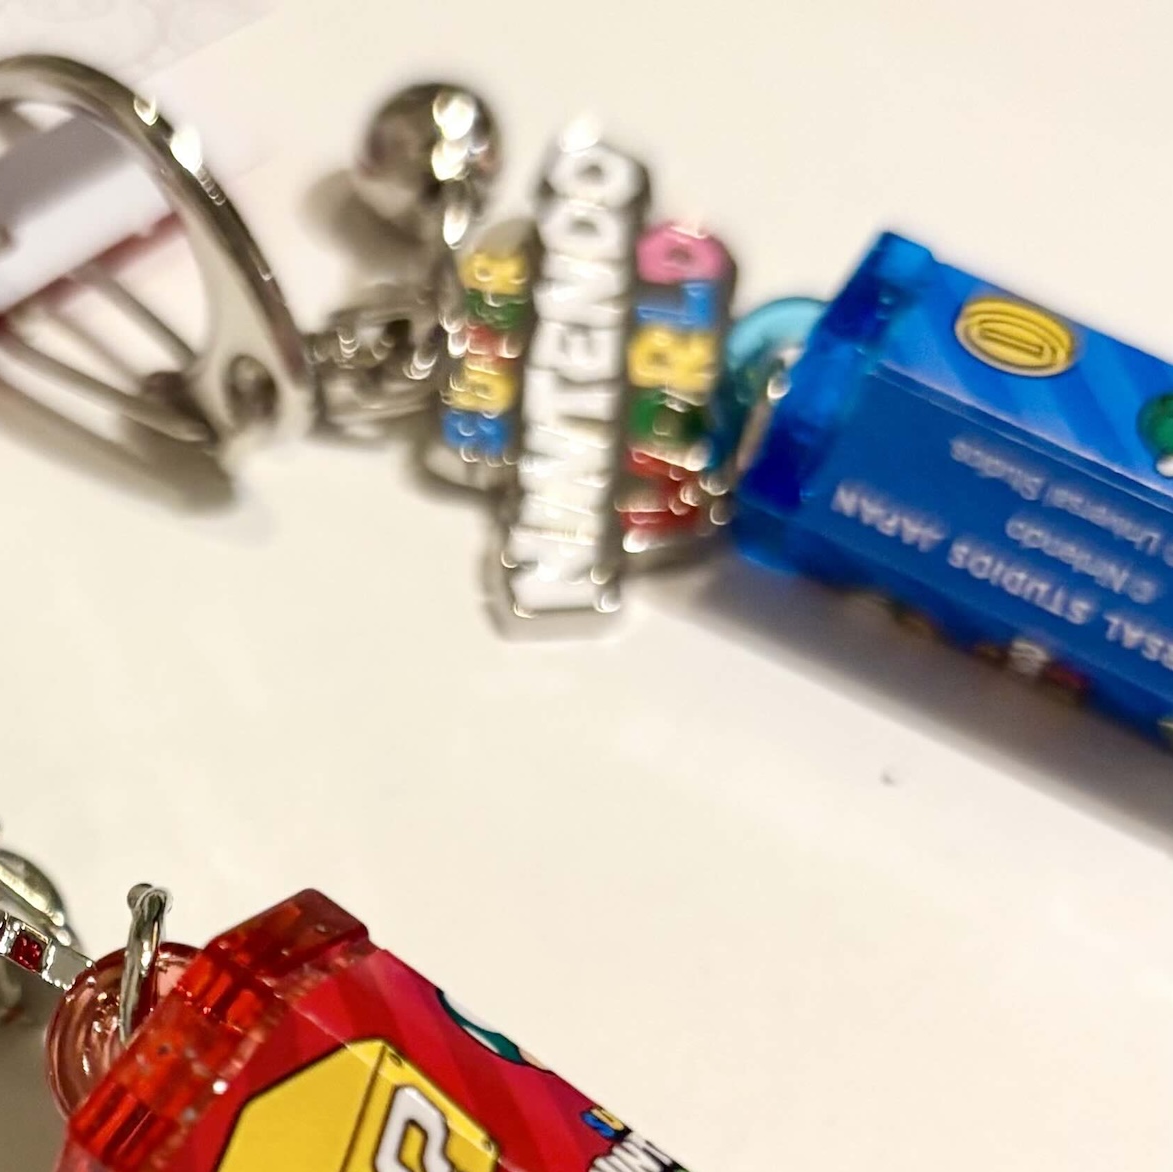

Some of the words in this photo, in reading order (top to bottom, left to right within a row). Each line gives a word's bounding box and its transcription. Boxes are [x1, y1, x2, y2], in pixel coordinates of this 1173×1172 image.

[508, 142, 642, 616] NINTENDO
[832, 482, 946, 563] JAPAN
[947, 542, 1094, 625] STUDIOS
